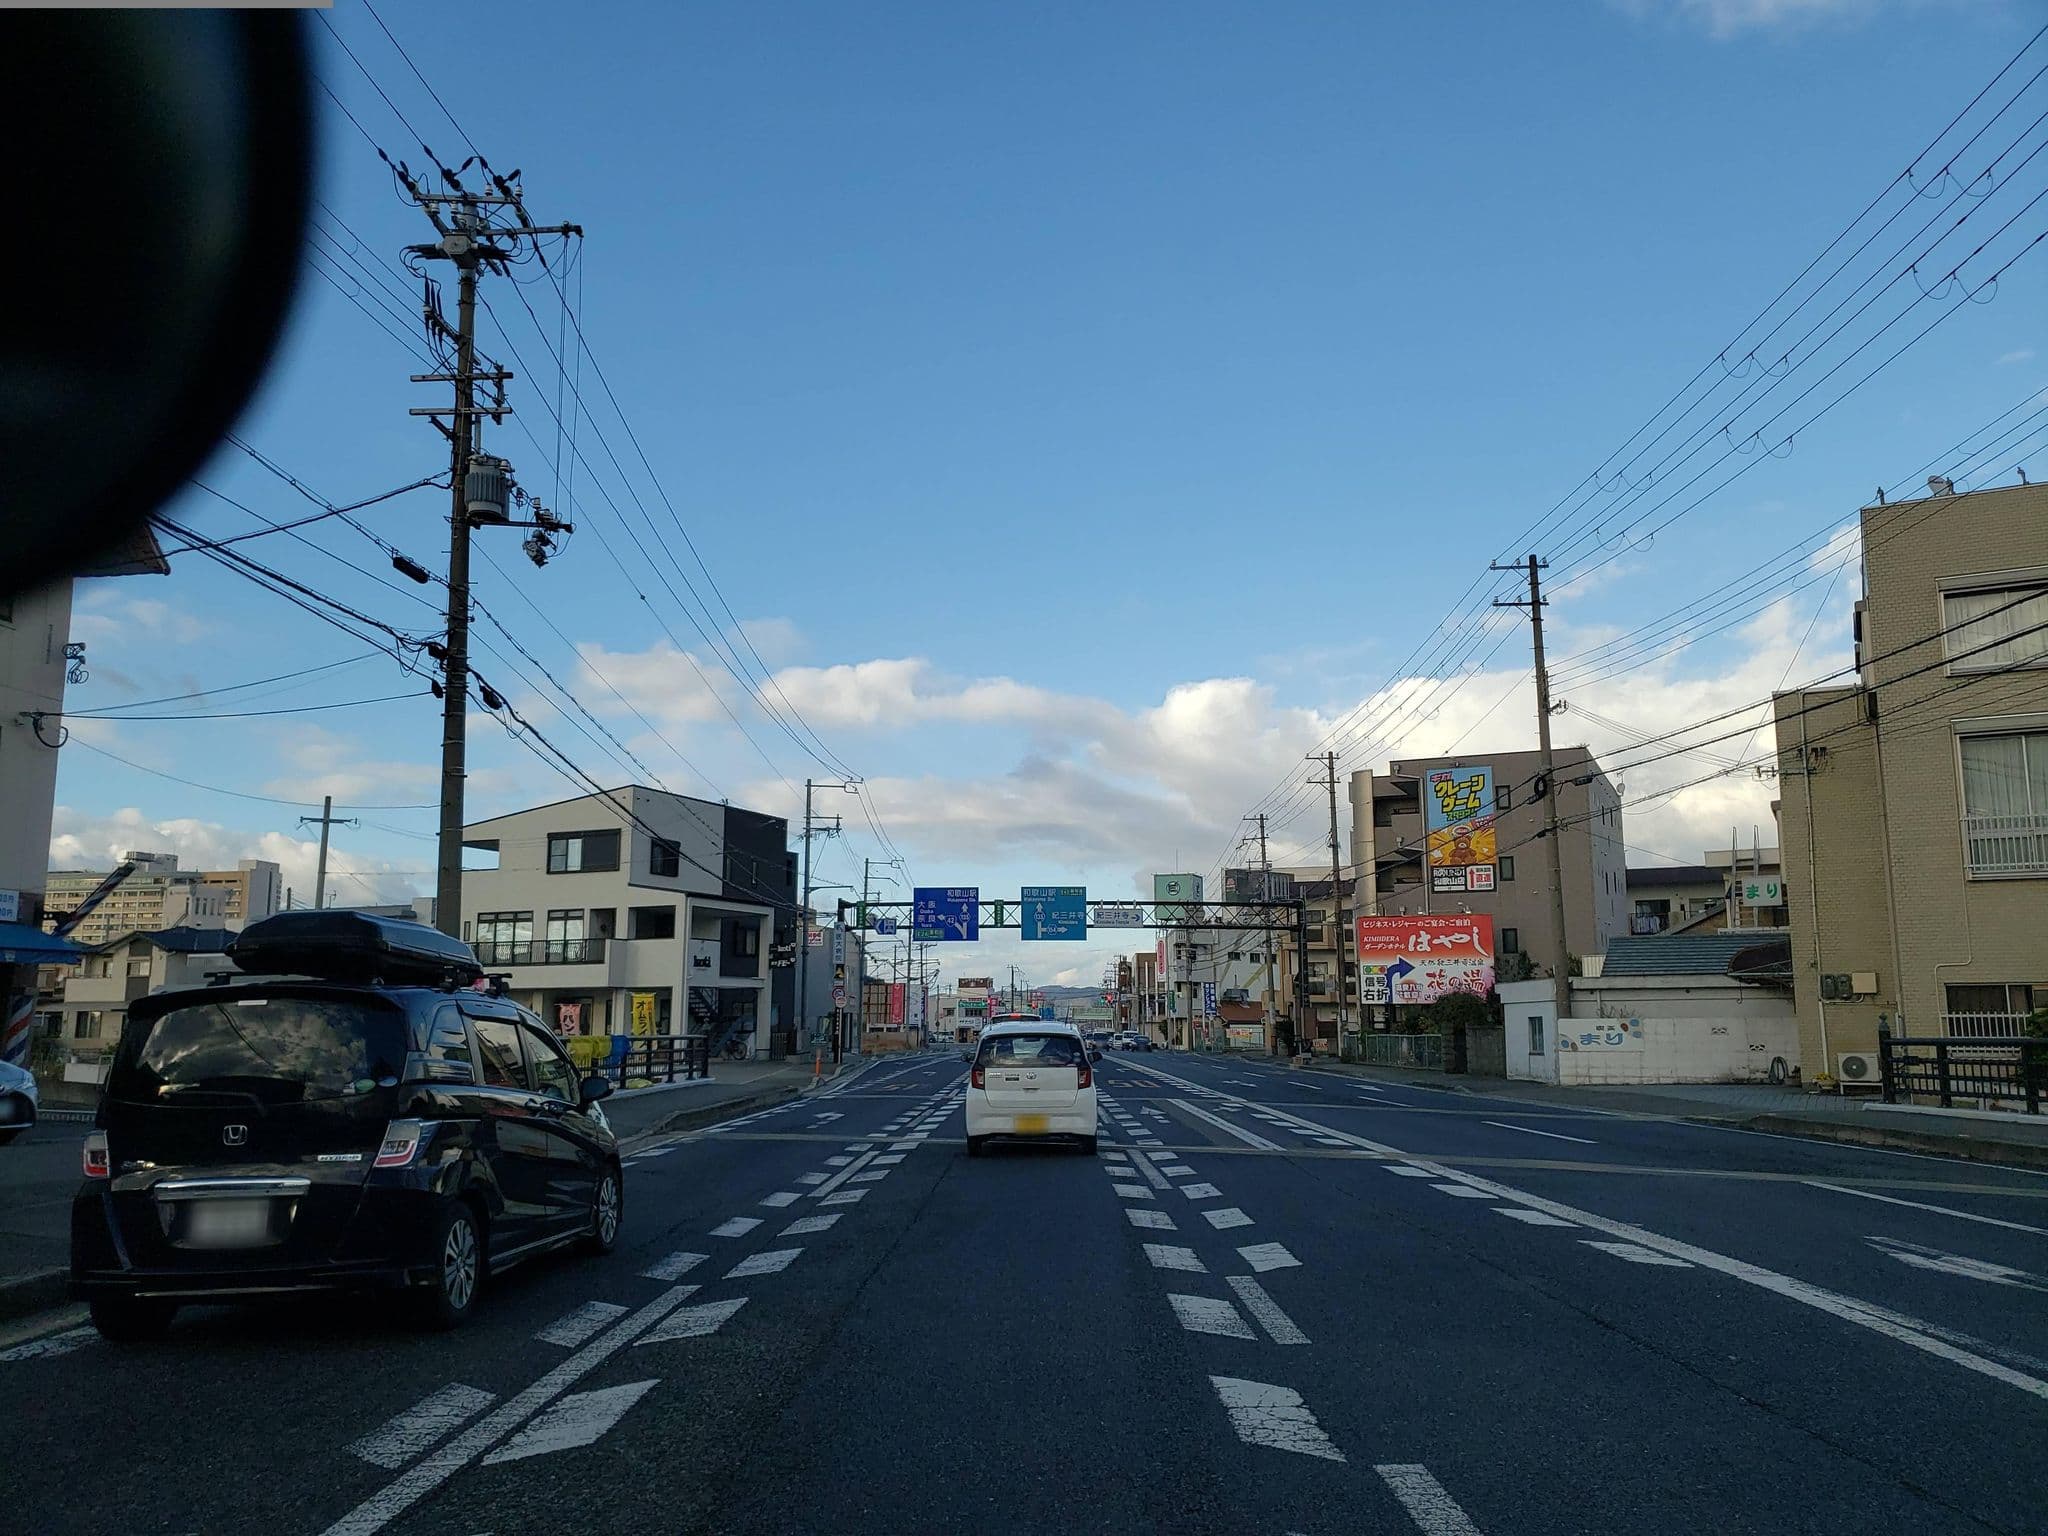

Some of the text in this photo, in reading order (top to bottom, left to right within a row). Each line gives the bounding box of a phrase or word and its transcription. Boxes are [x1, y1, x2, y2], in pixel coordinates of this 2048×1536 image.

[1435, 774, 1485, 798] クレーン
[947, 889, 976, 897] 和歌山駅
[1023, 888, 1056, 896] 和歌山駅
[1745, 883, 1778, 899] まり
[1096, 911, 1129, 919] 紀三井寺
[1364, 942, 1406, 951] ガーデンホテル
[1408, 926, 1489, 957] はやし
[1365, 976, 1387, 988] 信号
[1426, 968, 1486, 992] 花の湯
[1363, 988, 1389, 1001] 右折
[1580, 1033, 1624, 1046] まり
[1107, 1079, 1161, 1088] 50
